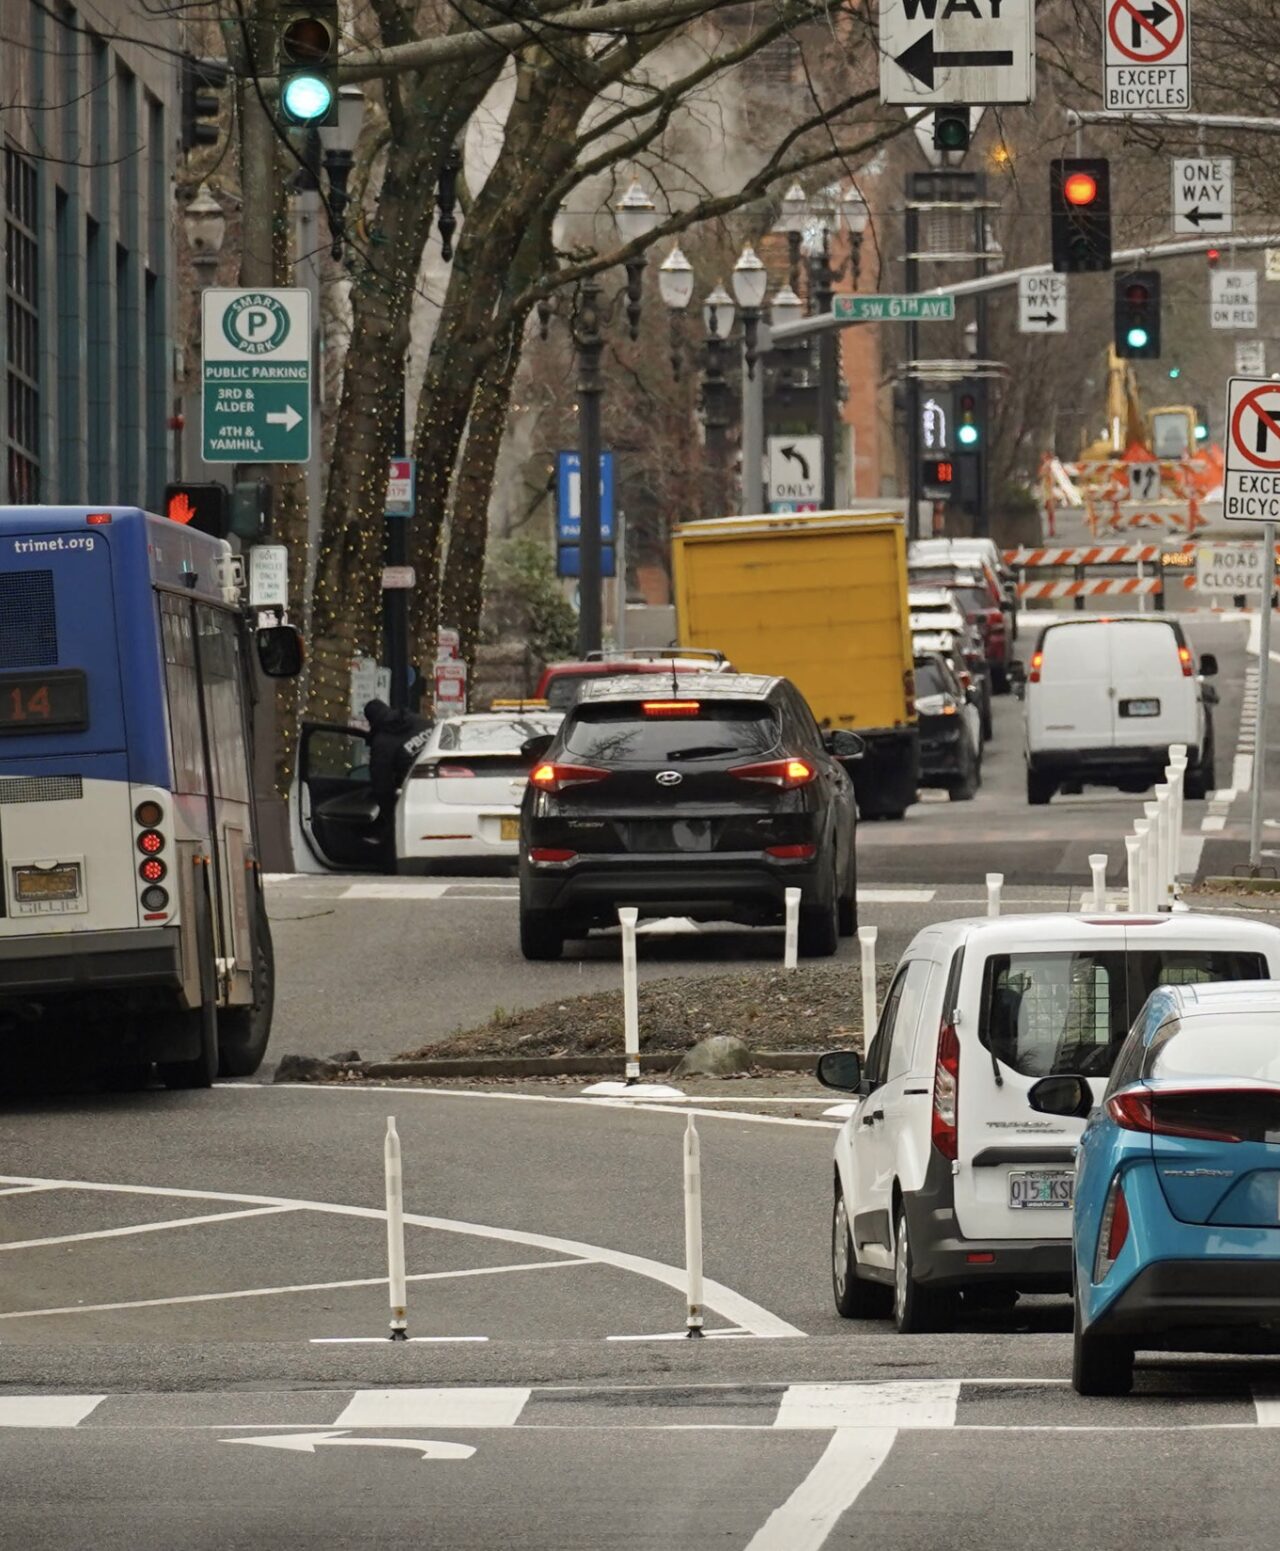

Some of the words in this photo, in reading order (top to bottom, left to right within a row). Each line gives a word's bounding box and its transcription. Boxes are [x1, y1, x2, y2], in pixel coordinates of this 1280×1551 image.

[1117, 70, 1176, 86] EXCEPT
[1110, 89, 1185, 104] BICYCLES
[1183, 164, 1222, 181] ONE
[1183, 184, 1224, 201] WAY
[1028, 278, 1058, 291] ONE
[1226, 277, 1242, 288] NO
[233, 296, 280, 312] SMART
[1028, 295, 1060, 307] WAY
[1220, 294, 1249, 305] TURN
[861, 303, 884, 318] SW
[889, 299, 919, 317] 6TH
[922, 302, 948, 317] AVE
[1214, 311, 1229, 322] ON
[1233, 311, 1255, 322] RED
[248, 311, 267, 337] P
[238, 340, 277, 353] PARK
[206, 367, 249, 378] PUBLIC
[252, 367, 307, 378] PARKING
[218, 388, 242, 399] 3RD
[245, 388, 255, 399] &
[215, 401, 255, 412] ALDER
[219, 426, 242, 436] 4TH
[245, 426, 255, 436] &
[210, 439, 264, 450] YAMHILL
[776, 484, 815, 497] ONLY
[14, 537, 95, 553] trimet.org
[1213, 553, 1259, 569] ROAD
[10, 684, 50, 720] 14
[1012, 1180, 1040, 1200] 015
